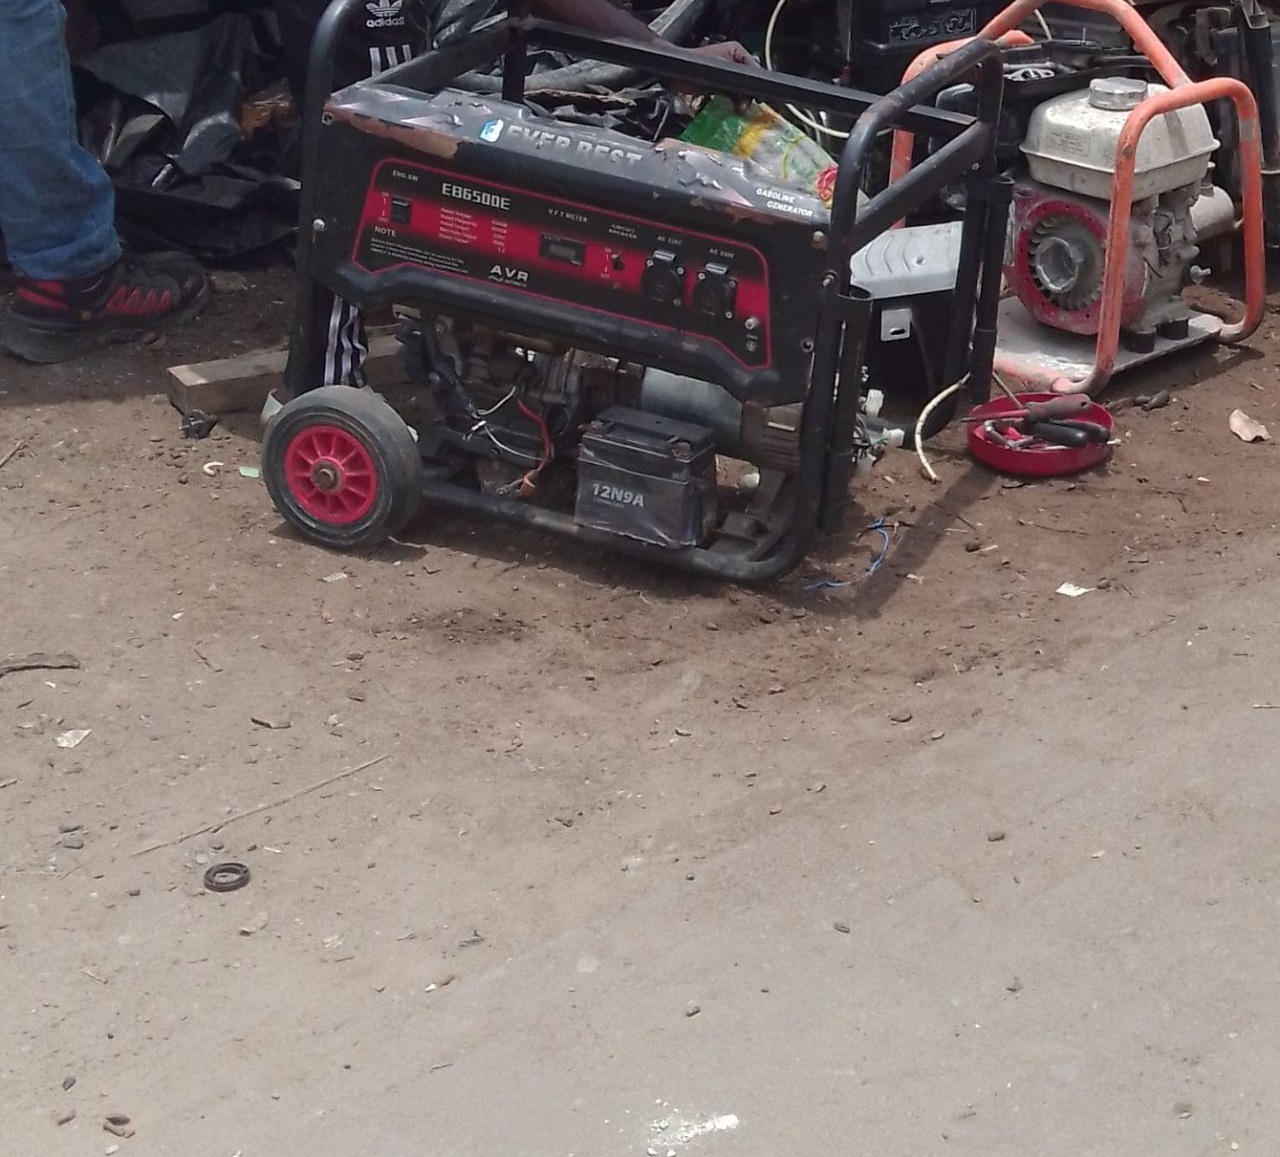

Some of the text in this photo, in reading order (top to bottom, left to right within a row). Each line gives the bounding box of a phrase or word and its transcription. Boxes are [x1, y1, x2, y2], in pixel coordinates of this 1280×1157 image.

[366, 16, 405, 28] adidas
[441, 182, 511, 211] EB6500E
[755, 188, 796, 204] GASOLINE
[766, 200, 814, 218] GENERATOR
[374, 225, 397, 238] NOTE
[489, 264, 529, 282] AVR
[592, 483, 644, 507] 12N9A
